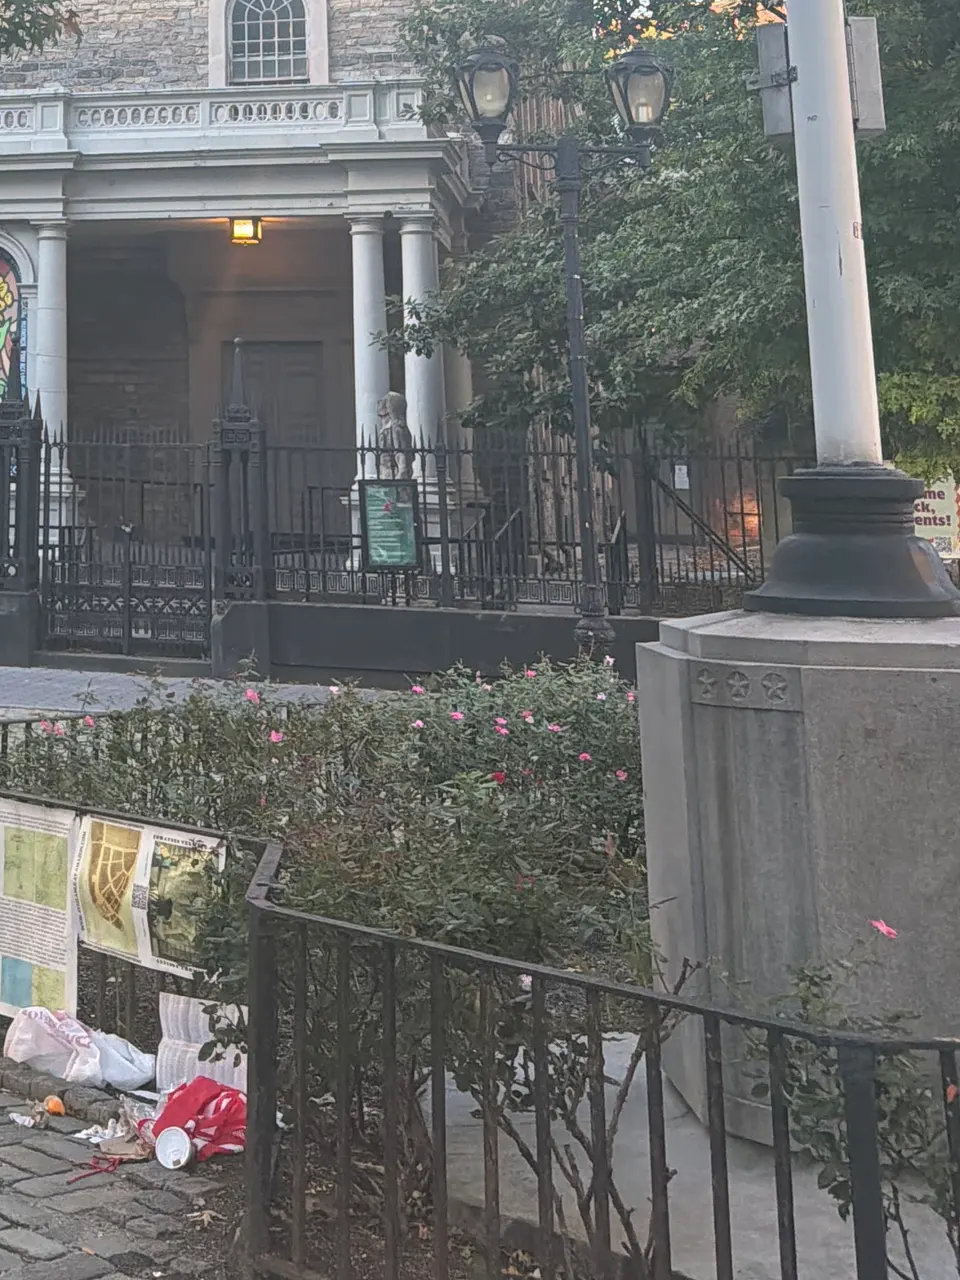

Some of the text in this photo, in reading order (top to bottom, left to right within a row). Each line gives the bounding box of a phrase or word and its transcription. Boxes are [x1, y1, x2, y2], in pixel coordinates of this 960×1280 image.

[924, 490, 945, 500] me
[914, 502, 936, 514] ck,
[914, 515, 951, 526] ents!
